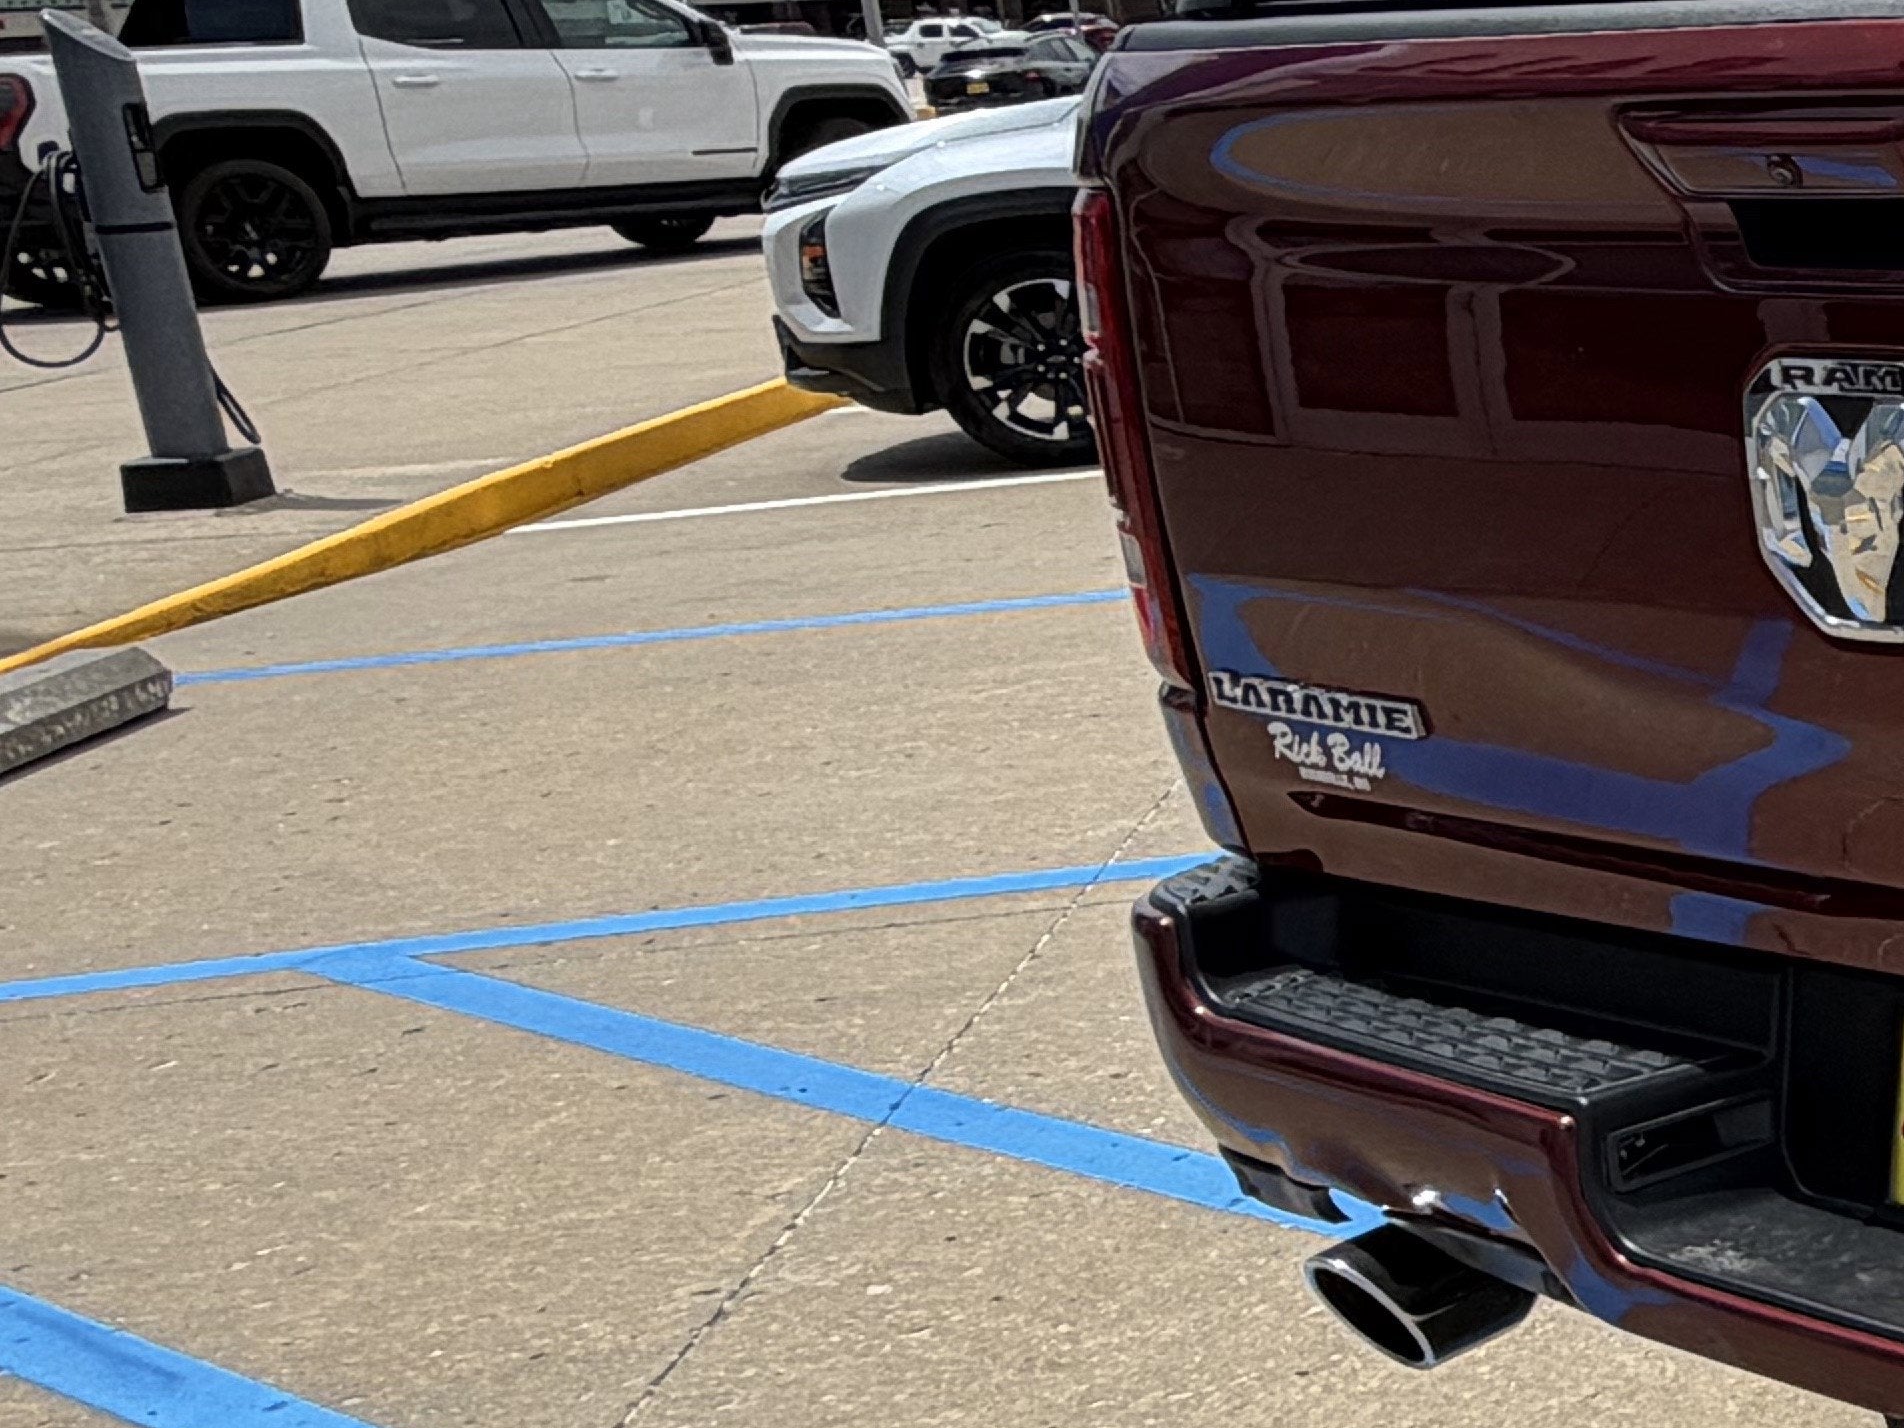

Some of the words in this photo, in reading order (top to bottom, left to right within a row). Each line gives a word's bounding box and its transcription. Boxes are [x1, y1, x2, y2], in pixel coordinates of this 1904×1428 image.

[1210, 673, 1413, 737] LARAMIE
[1267, 722, 1327, 767] Rick
[1327, 732, 1385, 779] Ball
